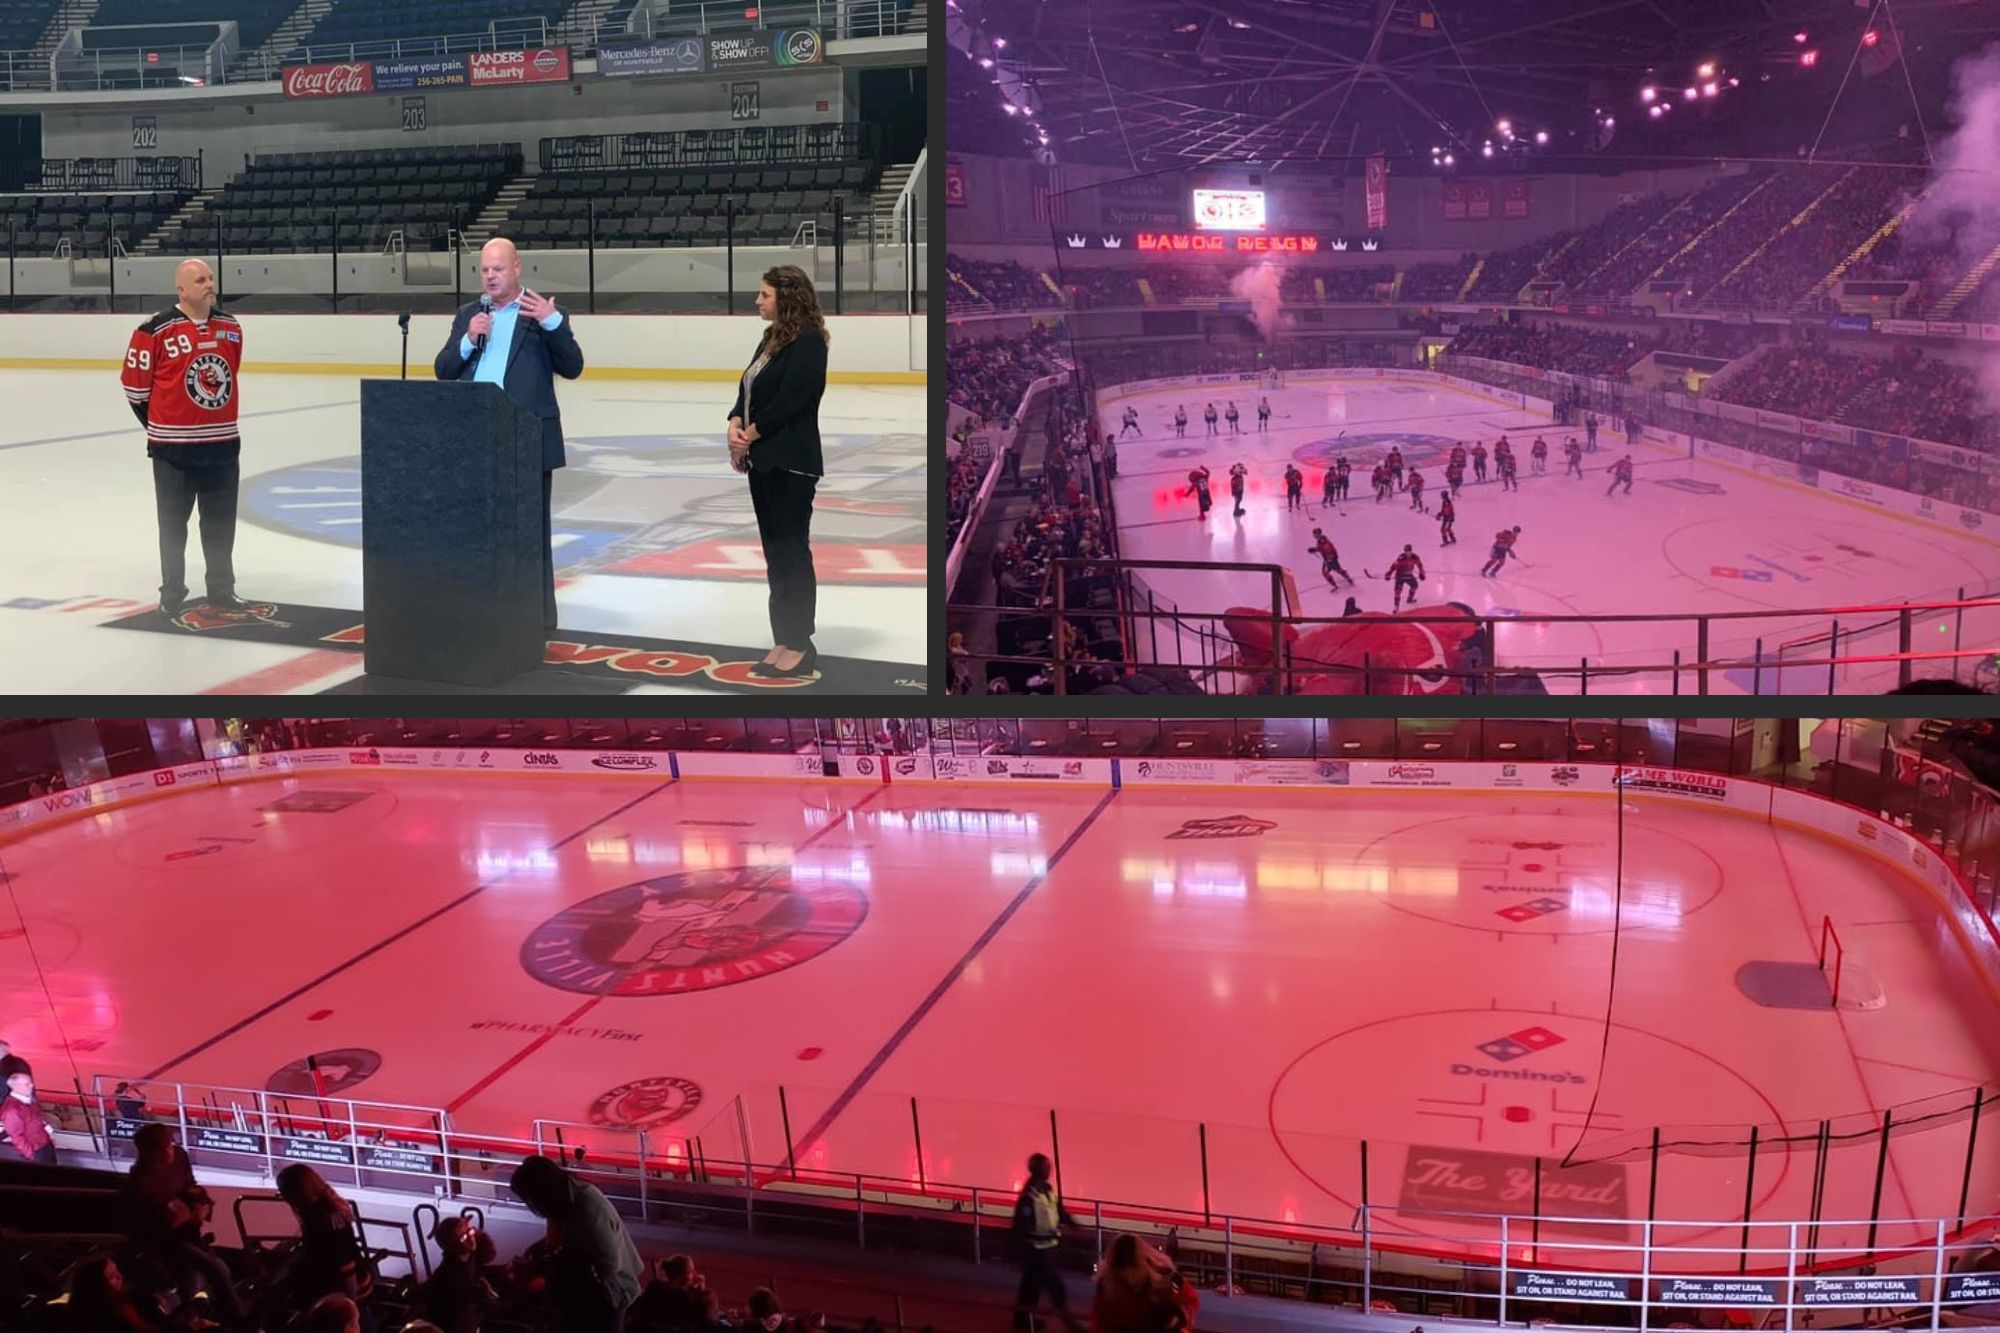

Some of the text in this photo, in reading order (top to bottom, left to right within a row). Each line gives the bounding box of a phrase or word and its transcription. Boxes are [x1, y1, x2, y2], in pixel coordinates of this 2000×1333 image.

[600, 46, 676, 60] Mercedes-Benz
[711, 38, 754, 51] SHOW UP
[719, 48, 748, 59] SHOW
[375, 60, 464, 74] We relieve your pain.
[471, 52, 525, 67] LANDERS
[289, 65, 366, 96] Coca-Cola
[473, 67, 524, 79] McLarty
[733, 94, 759, 118] 204
[403, 108, 425, 129] 203
[134, 127, 155, 146] 202
[164, 334, 193, 358] 59
[127, 348, 151, 370] 59
[1450, 1063, 1586, 1085] Domino's
[1407, 1158, 1488, 1191] The
